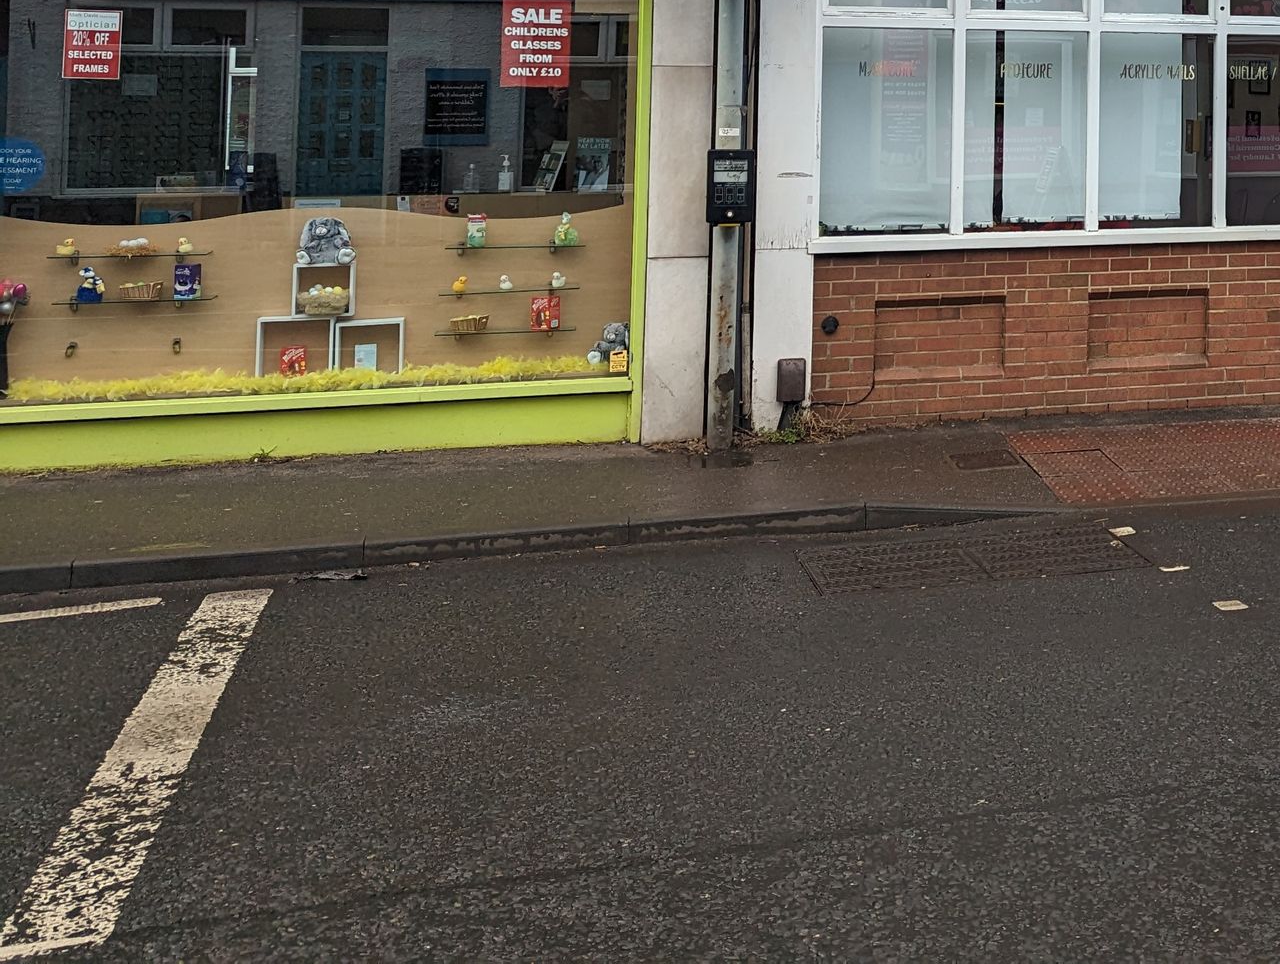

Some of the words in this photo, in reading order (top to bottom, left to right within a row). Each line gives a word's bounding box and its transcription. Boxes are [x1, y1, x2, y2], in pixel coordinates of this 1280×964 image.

[510, 7, 563, 24] SALE
[68, 19, 117, 29] Optician
[504, 26, 569, 37] CHILDRENS
[72, 31, 90, 46] 20%
[94, 32, 110, 46] OFF
[510, 40, 562, 50] GLASSES
[67, 50, 113, 60] SELECTED
[519, 54, 553, 63] FROM
[73, 64, 109, 73] FRAMES
[509, 67, 539, 76] ONLY
[540, 67, 562, 77] £10
[1000, 62, 1053, 79] PEDICURE
[1119, 64, 1163, 80] ACRYLIC
[1229, 65, 1268, 81] SHELLAC
